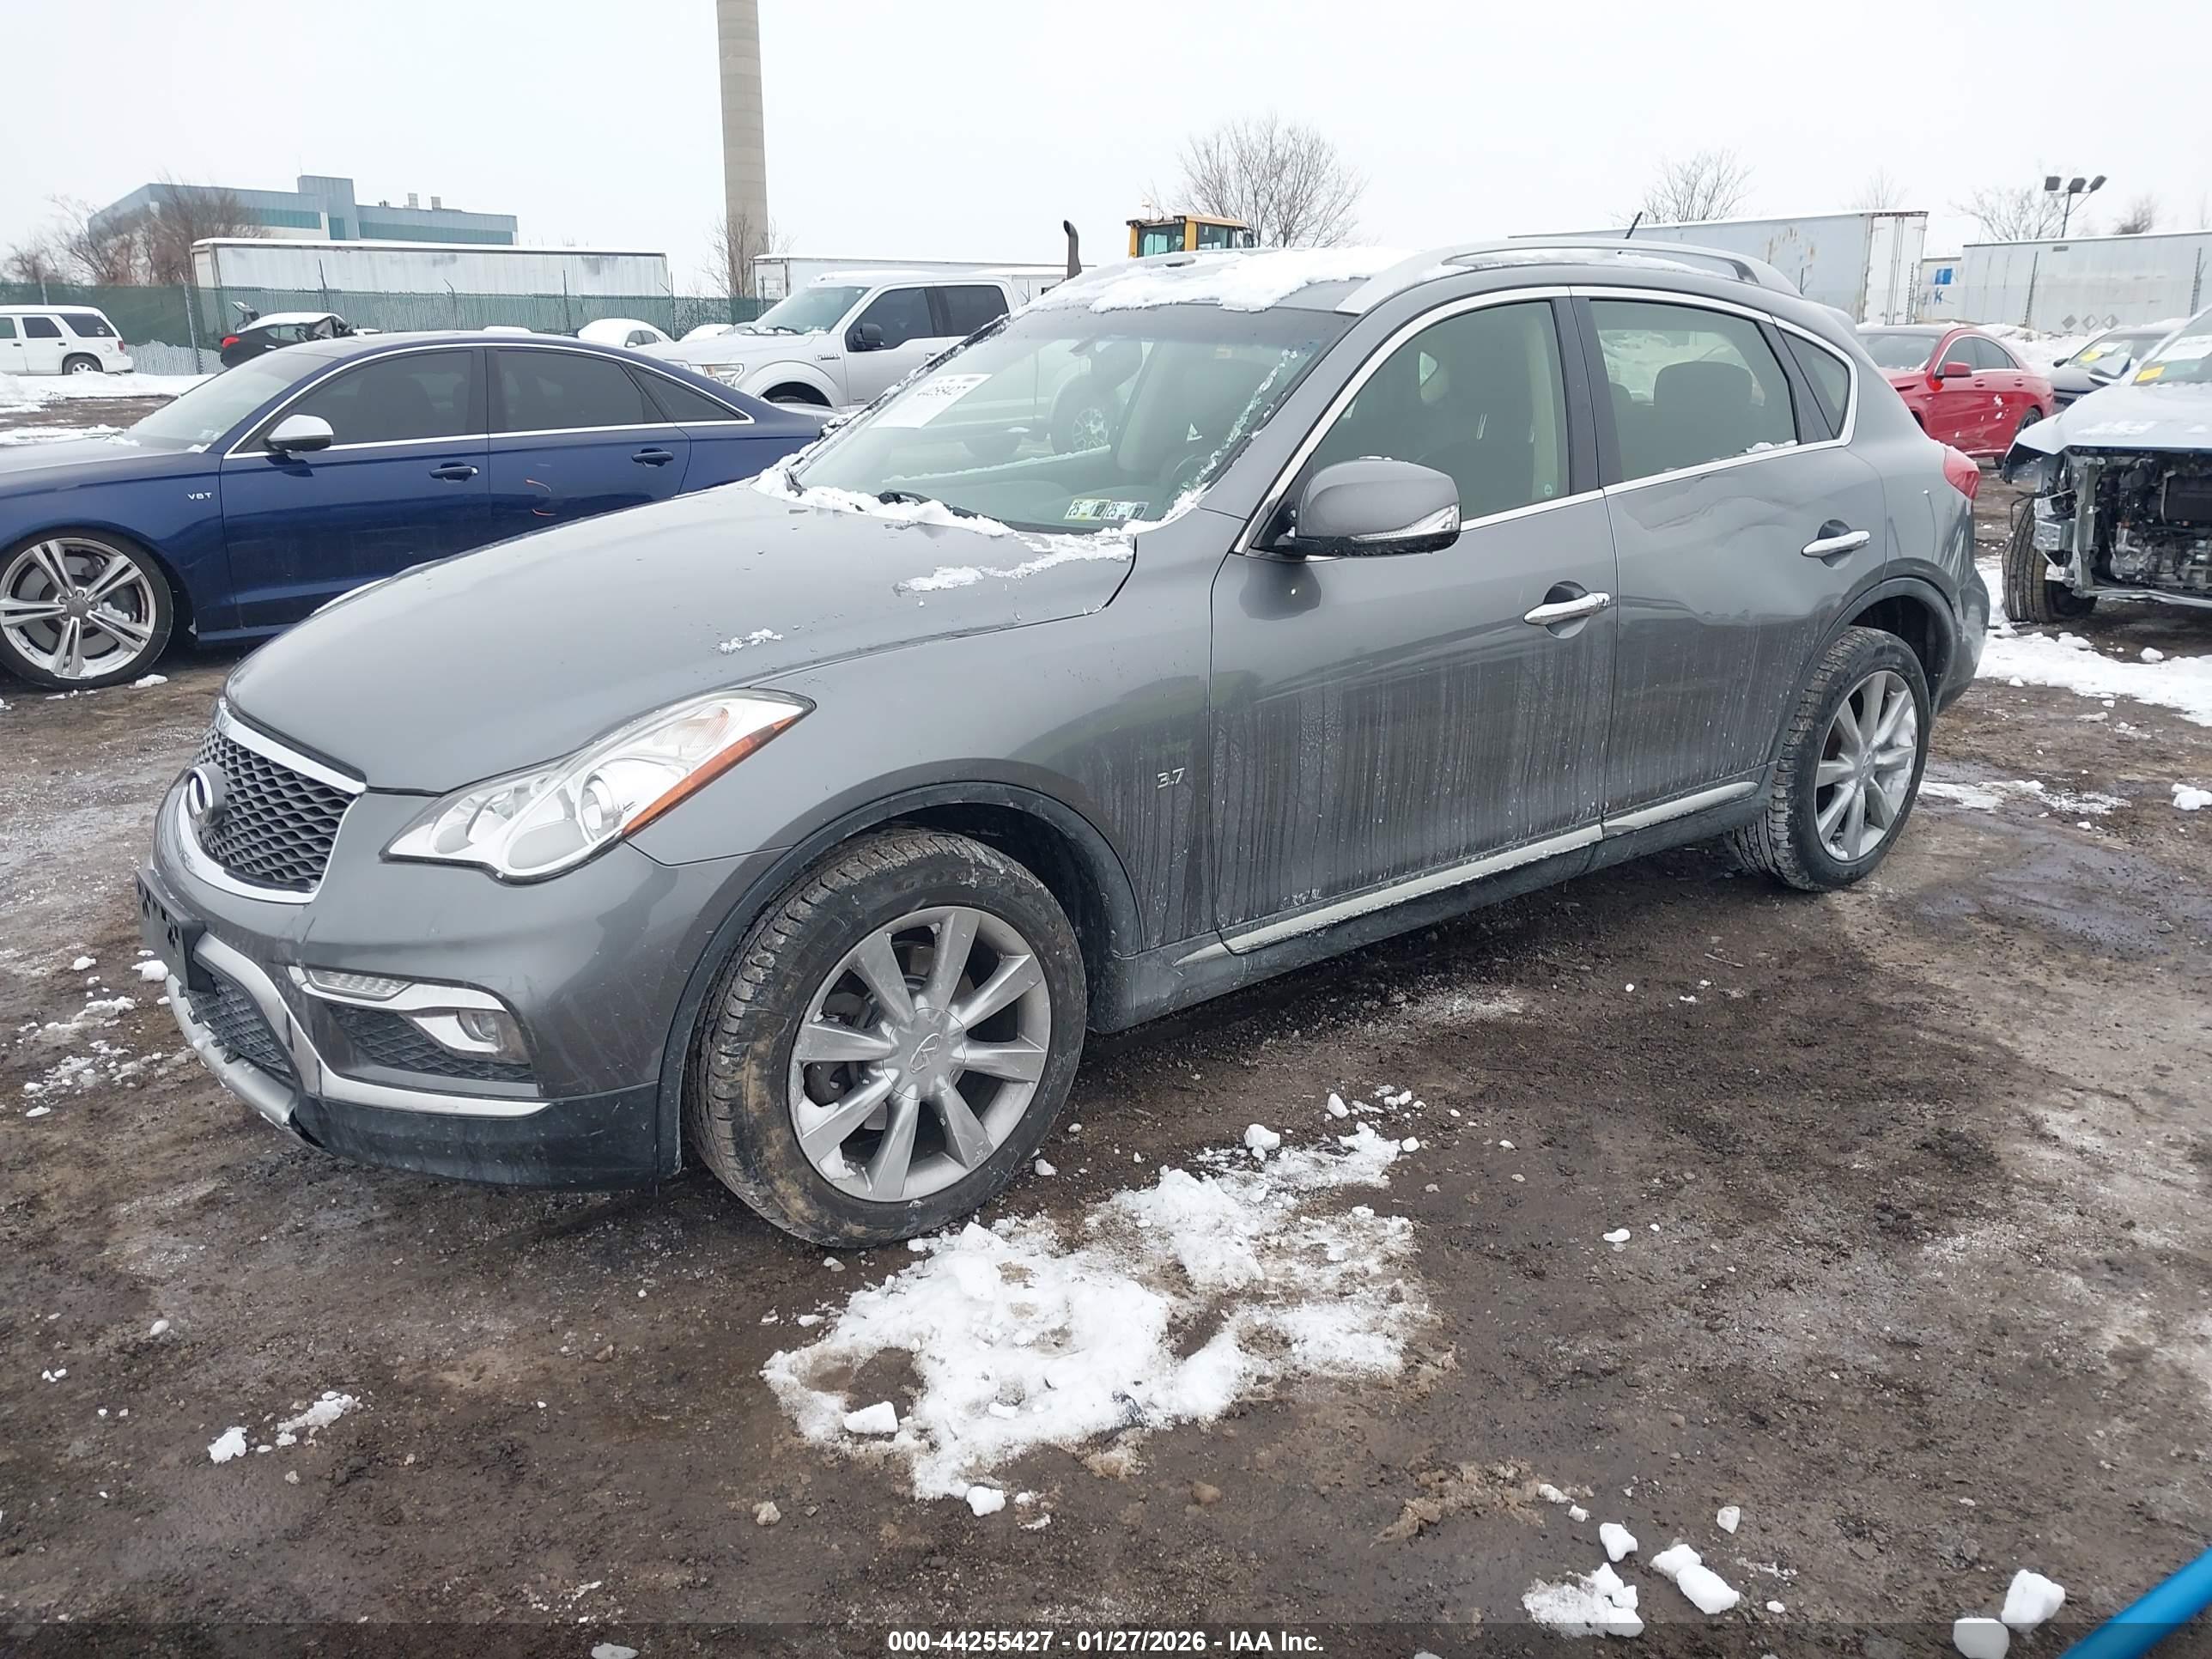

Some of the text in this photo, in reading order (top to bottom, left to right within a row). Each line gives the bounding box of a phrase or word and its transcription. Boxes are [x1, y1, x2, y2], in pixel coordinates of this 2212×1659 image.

[1068, 501, 1107, 517] 25 12
[1106, 502, 1121, 517] 25
[1157, 767, 1185, 789] 3.7
